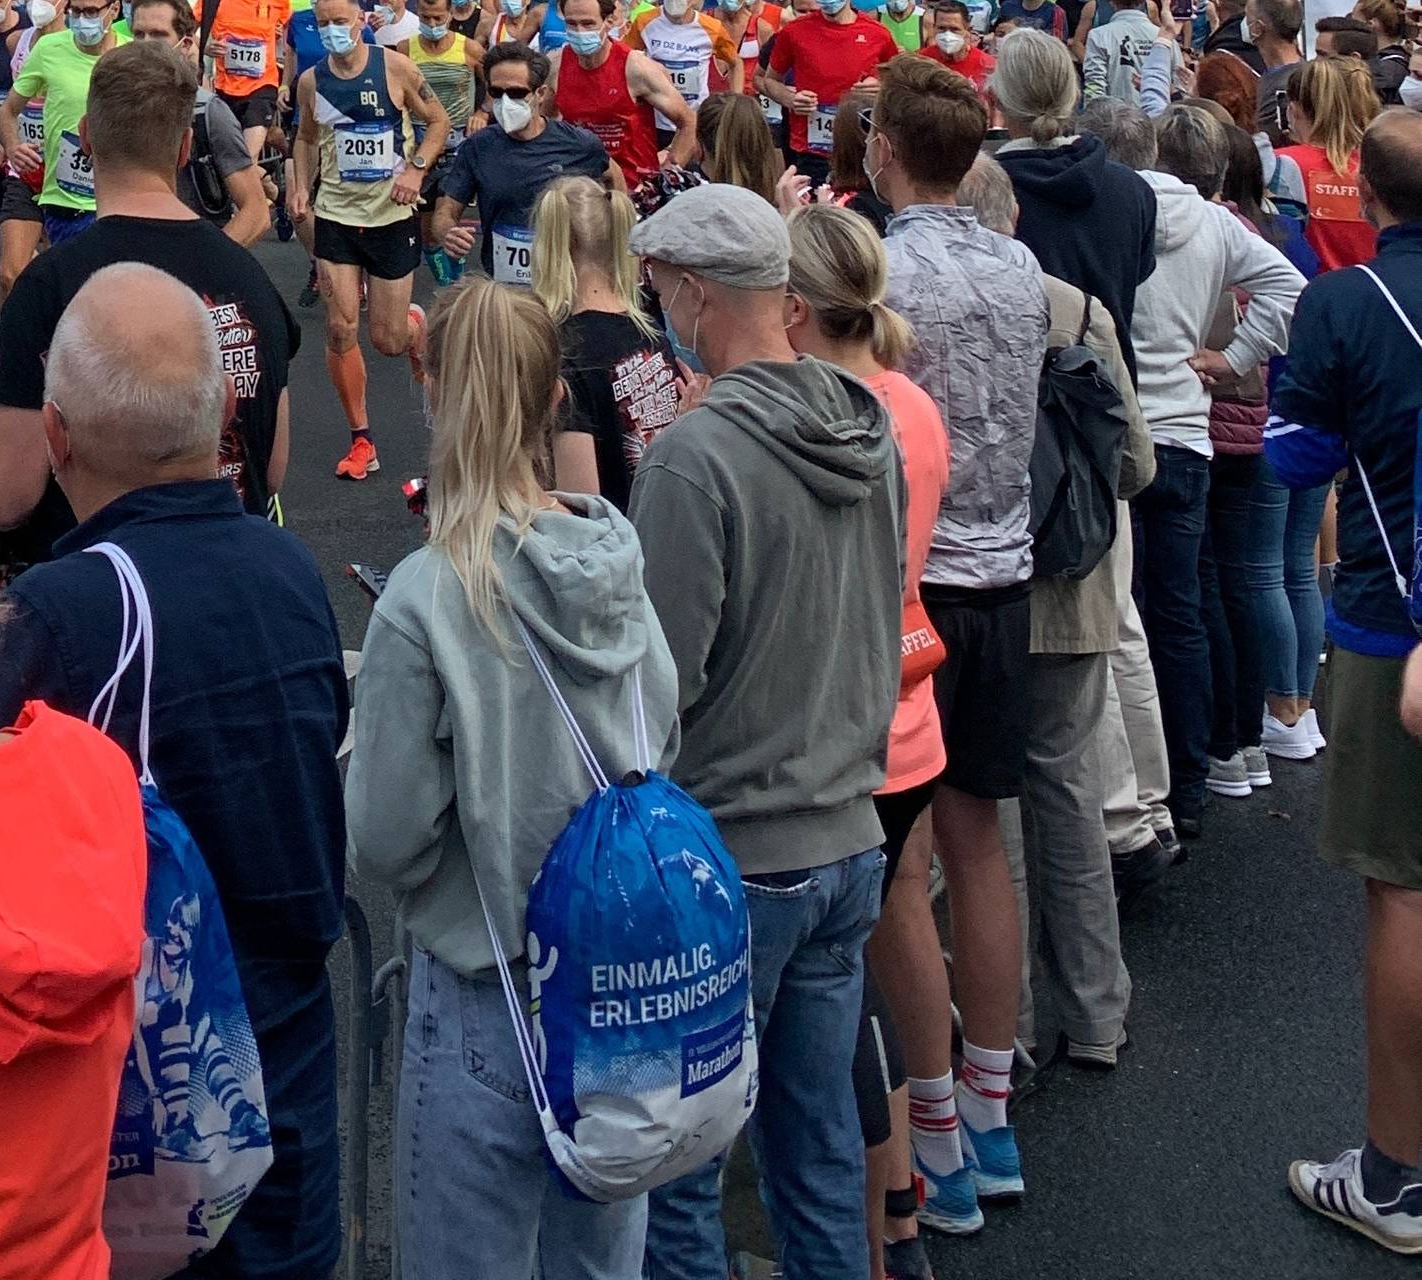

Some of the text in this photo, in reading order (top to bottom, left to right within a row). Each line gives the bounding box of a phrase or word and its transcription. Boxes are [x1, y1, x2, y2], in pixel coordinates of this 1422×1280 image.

[230, 49, 261, 62] 5178
[670, 73, 686, 85] 16
[360, 91, 378, 107] BQ
[344, 139, 384, 156] 2031
[506, 246, 531, 268] 70
[591, 942, 717, 993] EINMALIG.
[590, 950, 748, 1028] ERLEBNISREICH
[687, 1040, 741, 1085] Marathon
